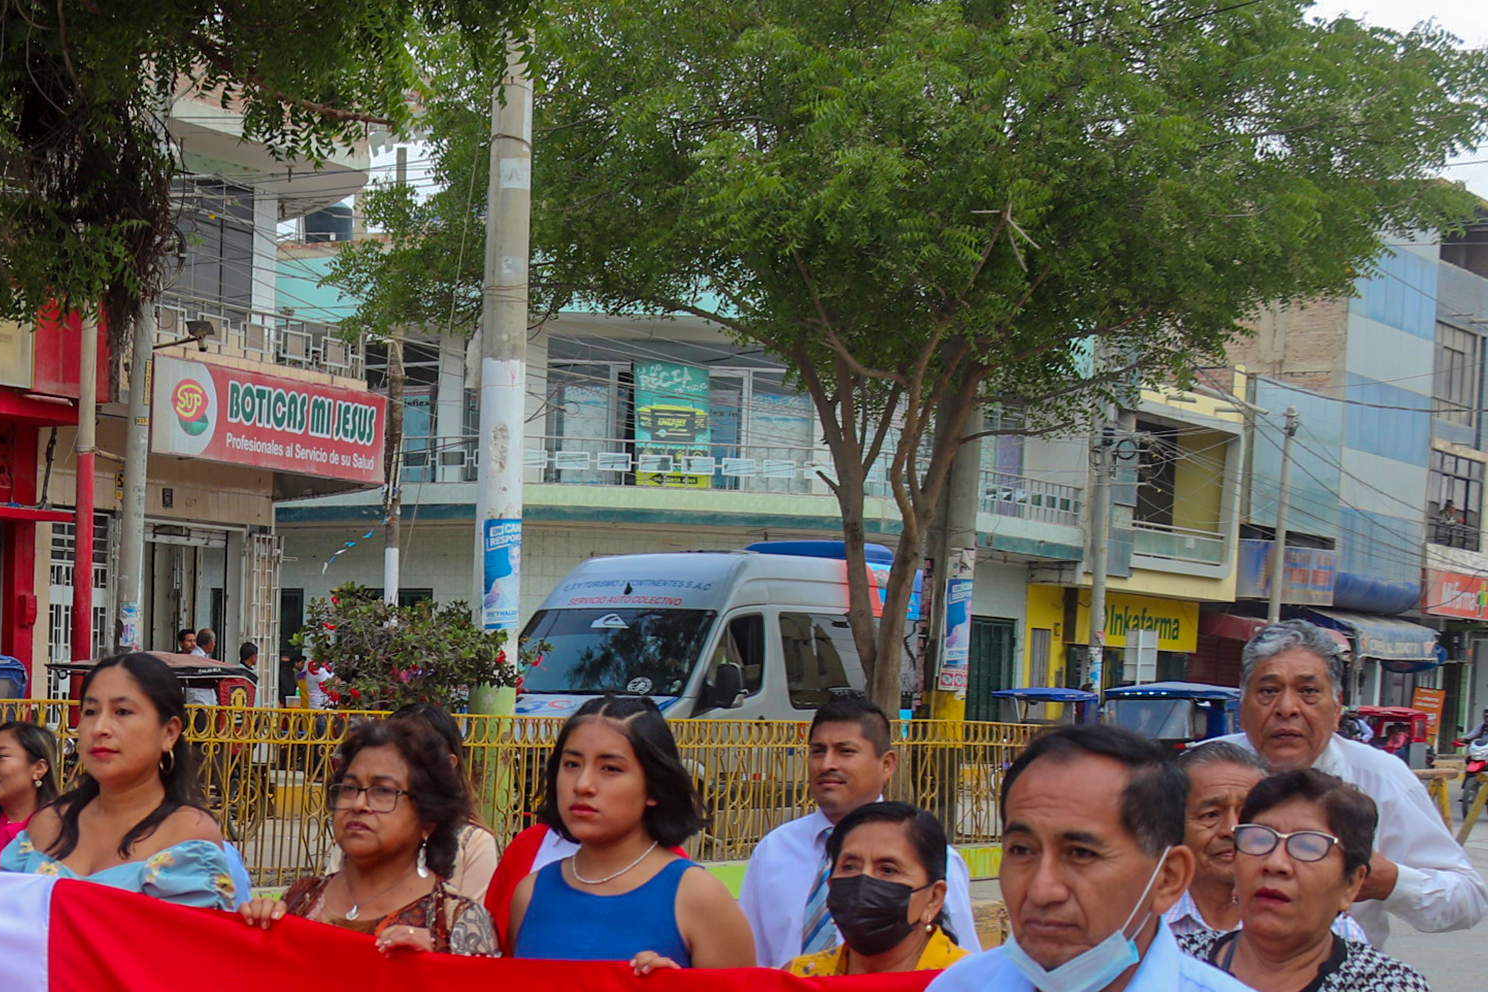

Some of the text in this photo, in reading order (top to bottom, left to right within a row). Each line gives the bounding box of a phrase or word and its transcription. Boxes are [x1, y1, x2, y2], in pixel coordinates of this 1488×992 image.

[228, 381, 376, 446] BOTICAS MI JESUS
[226, 433, 375, 471] Profesionales al Servicio de su Salud
[568, 596, 607, 606] SERVICIO
[1110, 604, 1180, 640] Inkafarma
